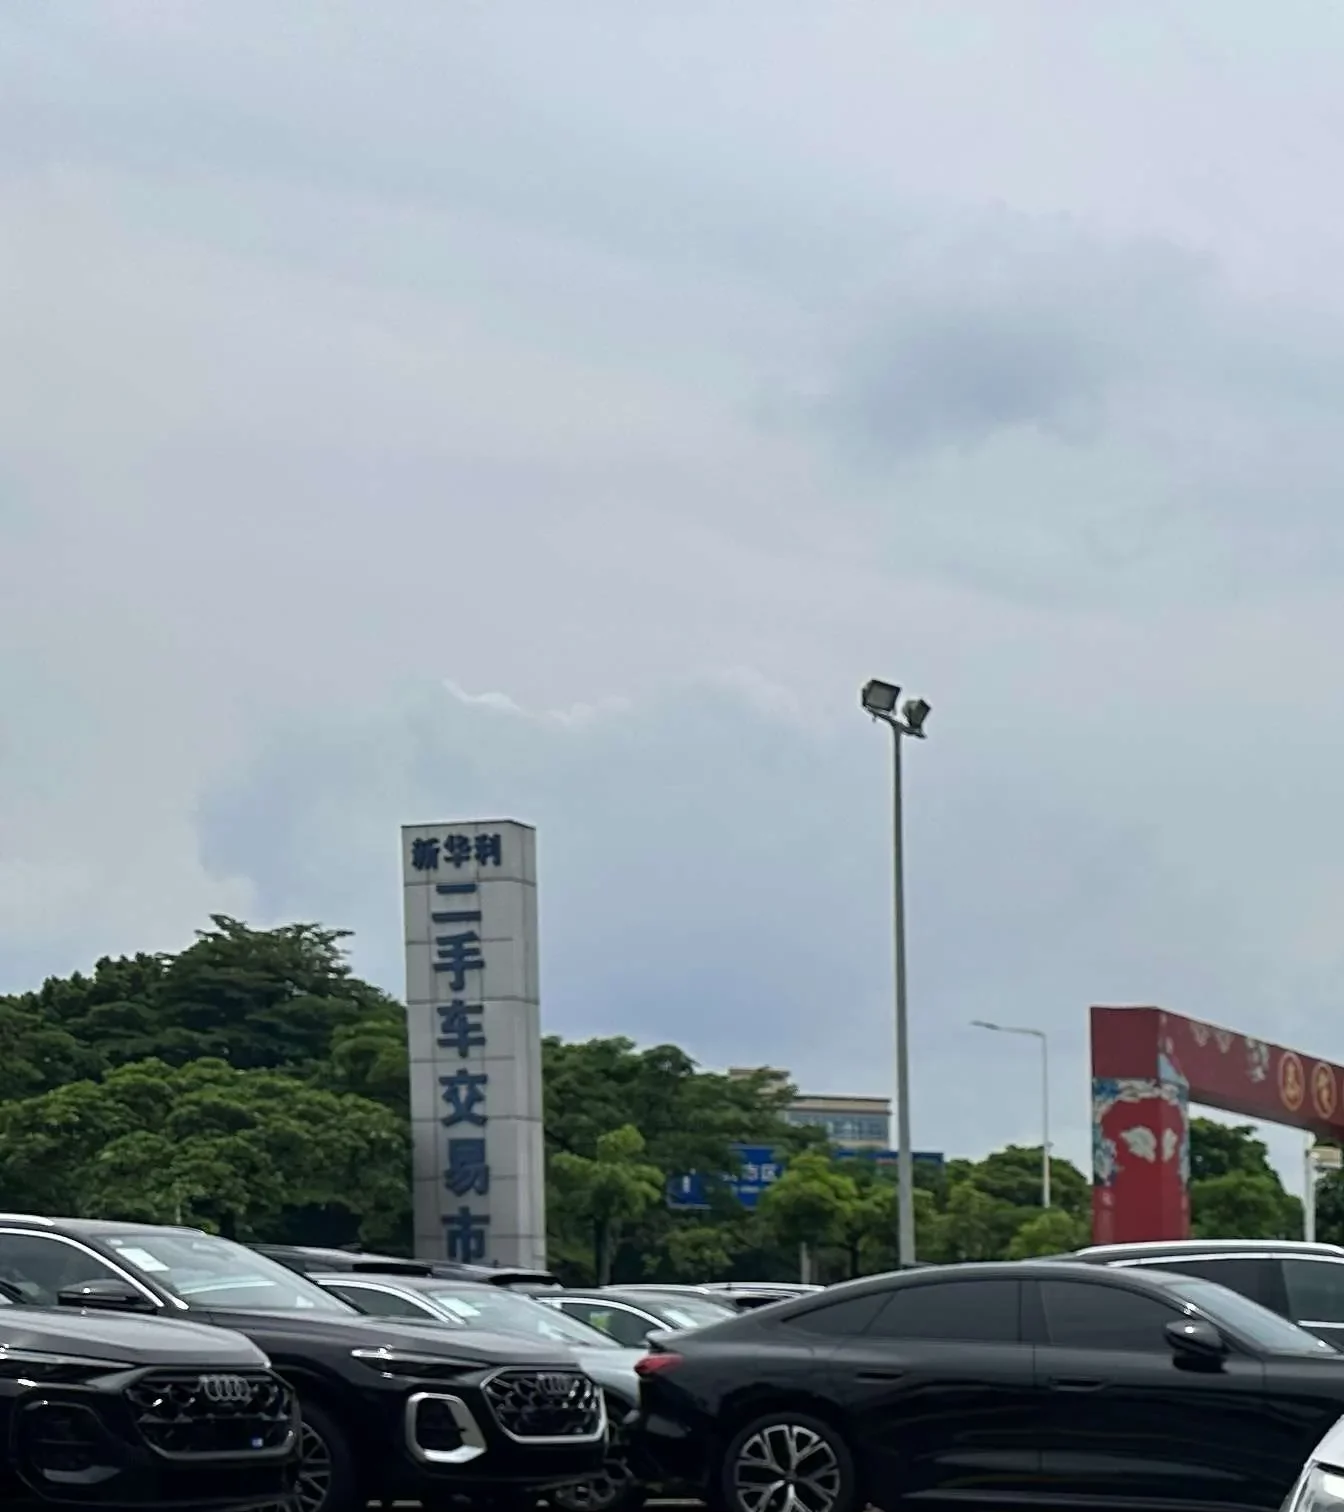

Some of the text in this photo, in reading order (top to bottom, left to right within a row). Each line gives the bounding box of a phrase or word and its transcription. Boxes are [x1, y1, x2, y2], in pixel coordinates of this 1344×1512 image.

[430, 882, 491, 1265] 二手车交易市
